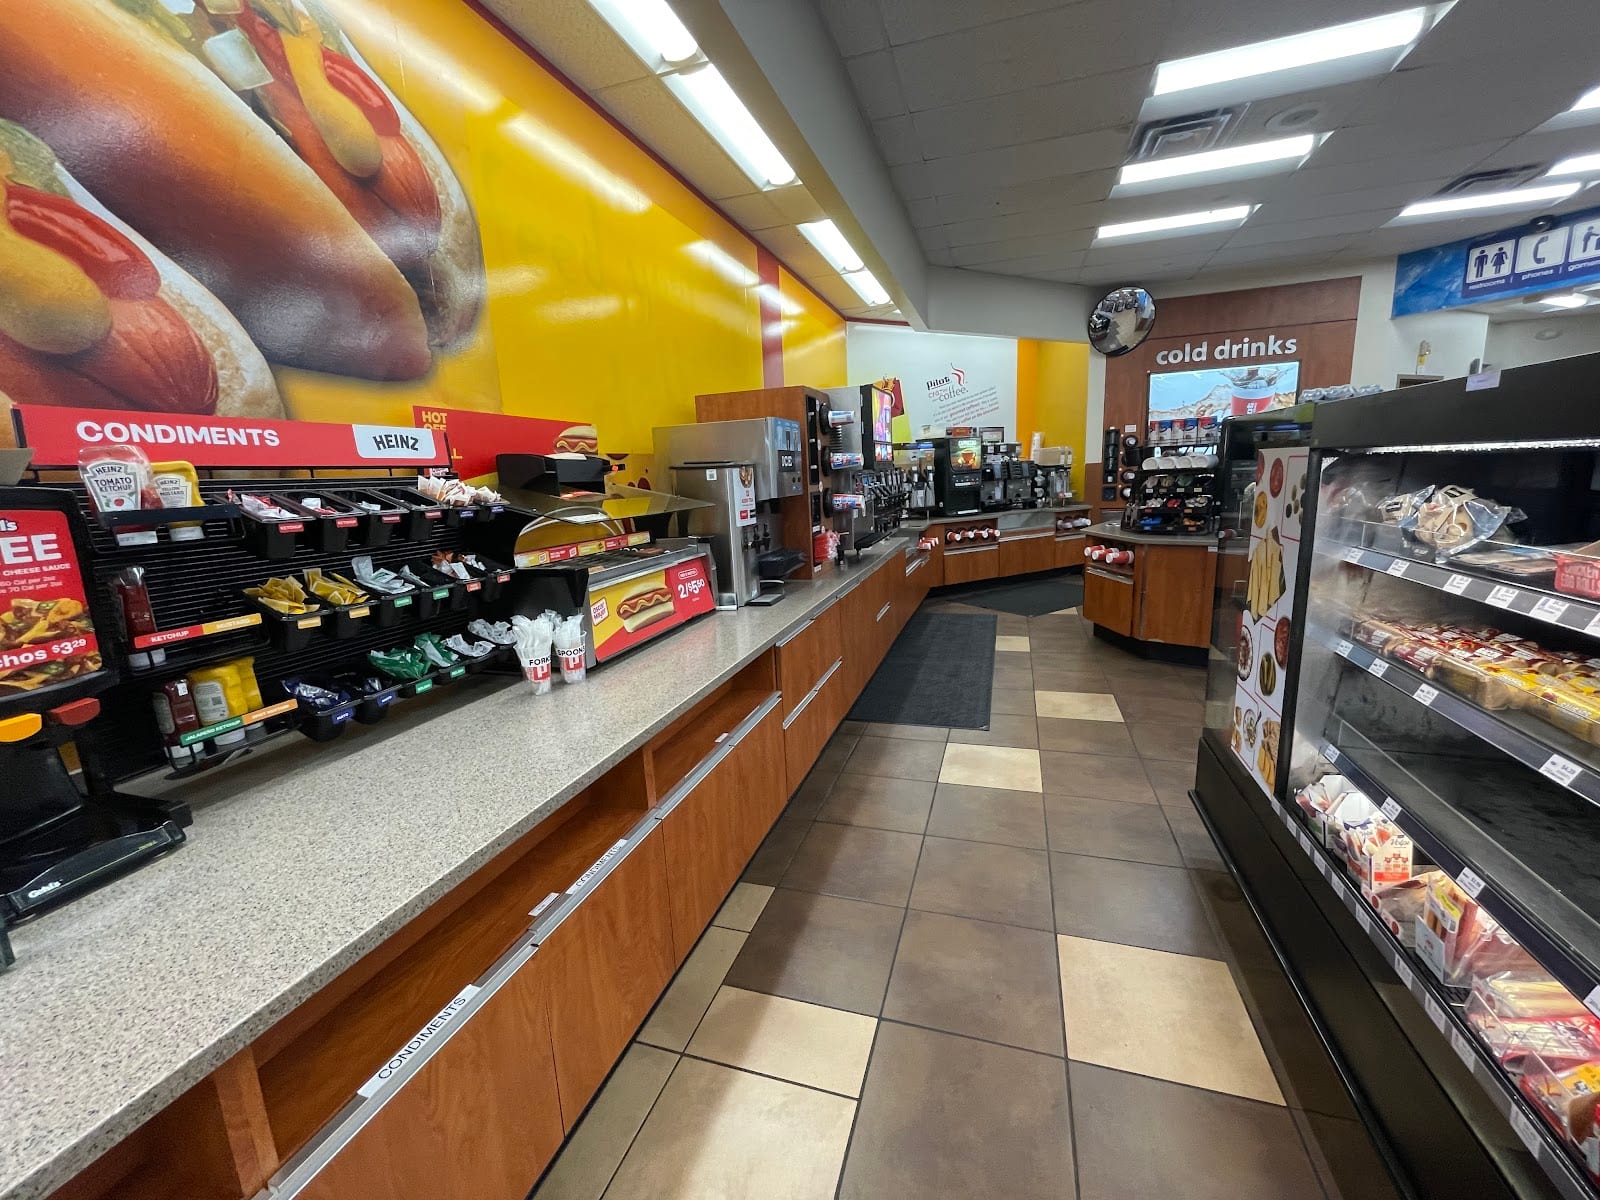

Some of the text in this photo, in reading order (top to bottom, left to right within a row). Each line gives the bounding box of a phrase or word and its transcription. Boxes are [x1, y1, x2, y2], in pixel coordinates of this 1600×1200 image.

[1469, 279, 1505, 290] restrooms
[1521, 269, 1554, 281] phones
[1156, 335, 1297, 366] cold drinks
[421, 411, 448, 424] HOT
[76, 420, 419, 452] CONDIMENTS HEINZ
[95, 465, 123, 474] HEINZ
[94, 476, 132, 488] TOMATO
[100, 484, 133, 493] KETCHUP
[2, 562, 72, 577] CHEESE SAUCE
[150, 629, 190, 643] KETCHUP
[378, 997, 466, 1080] CONDIMENTS
